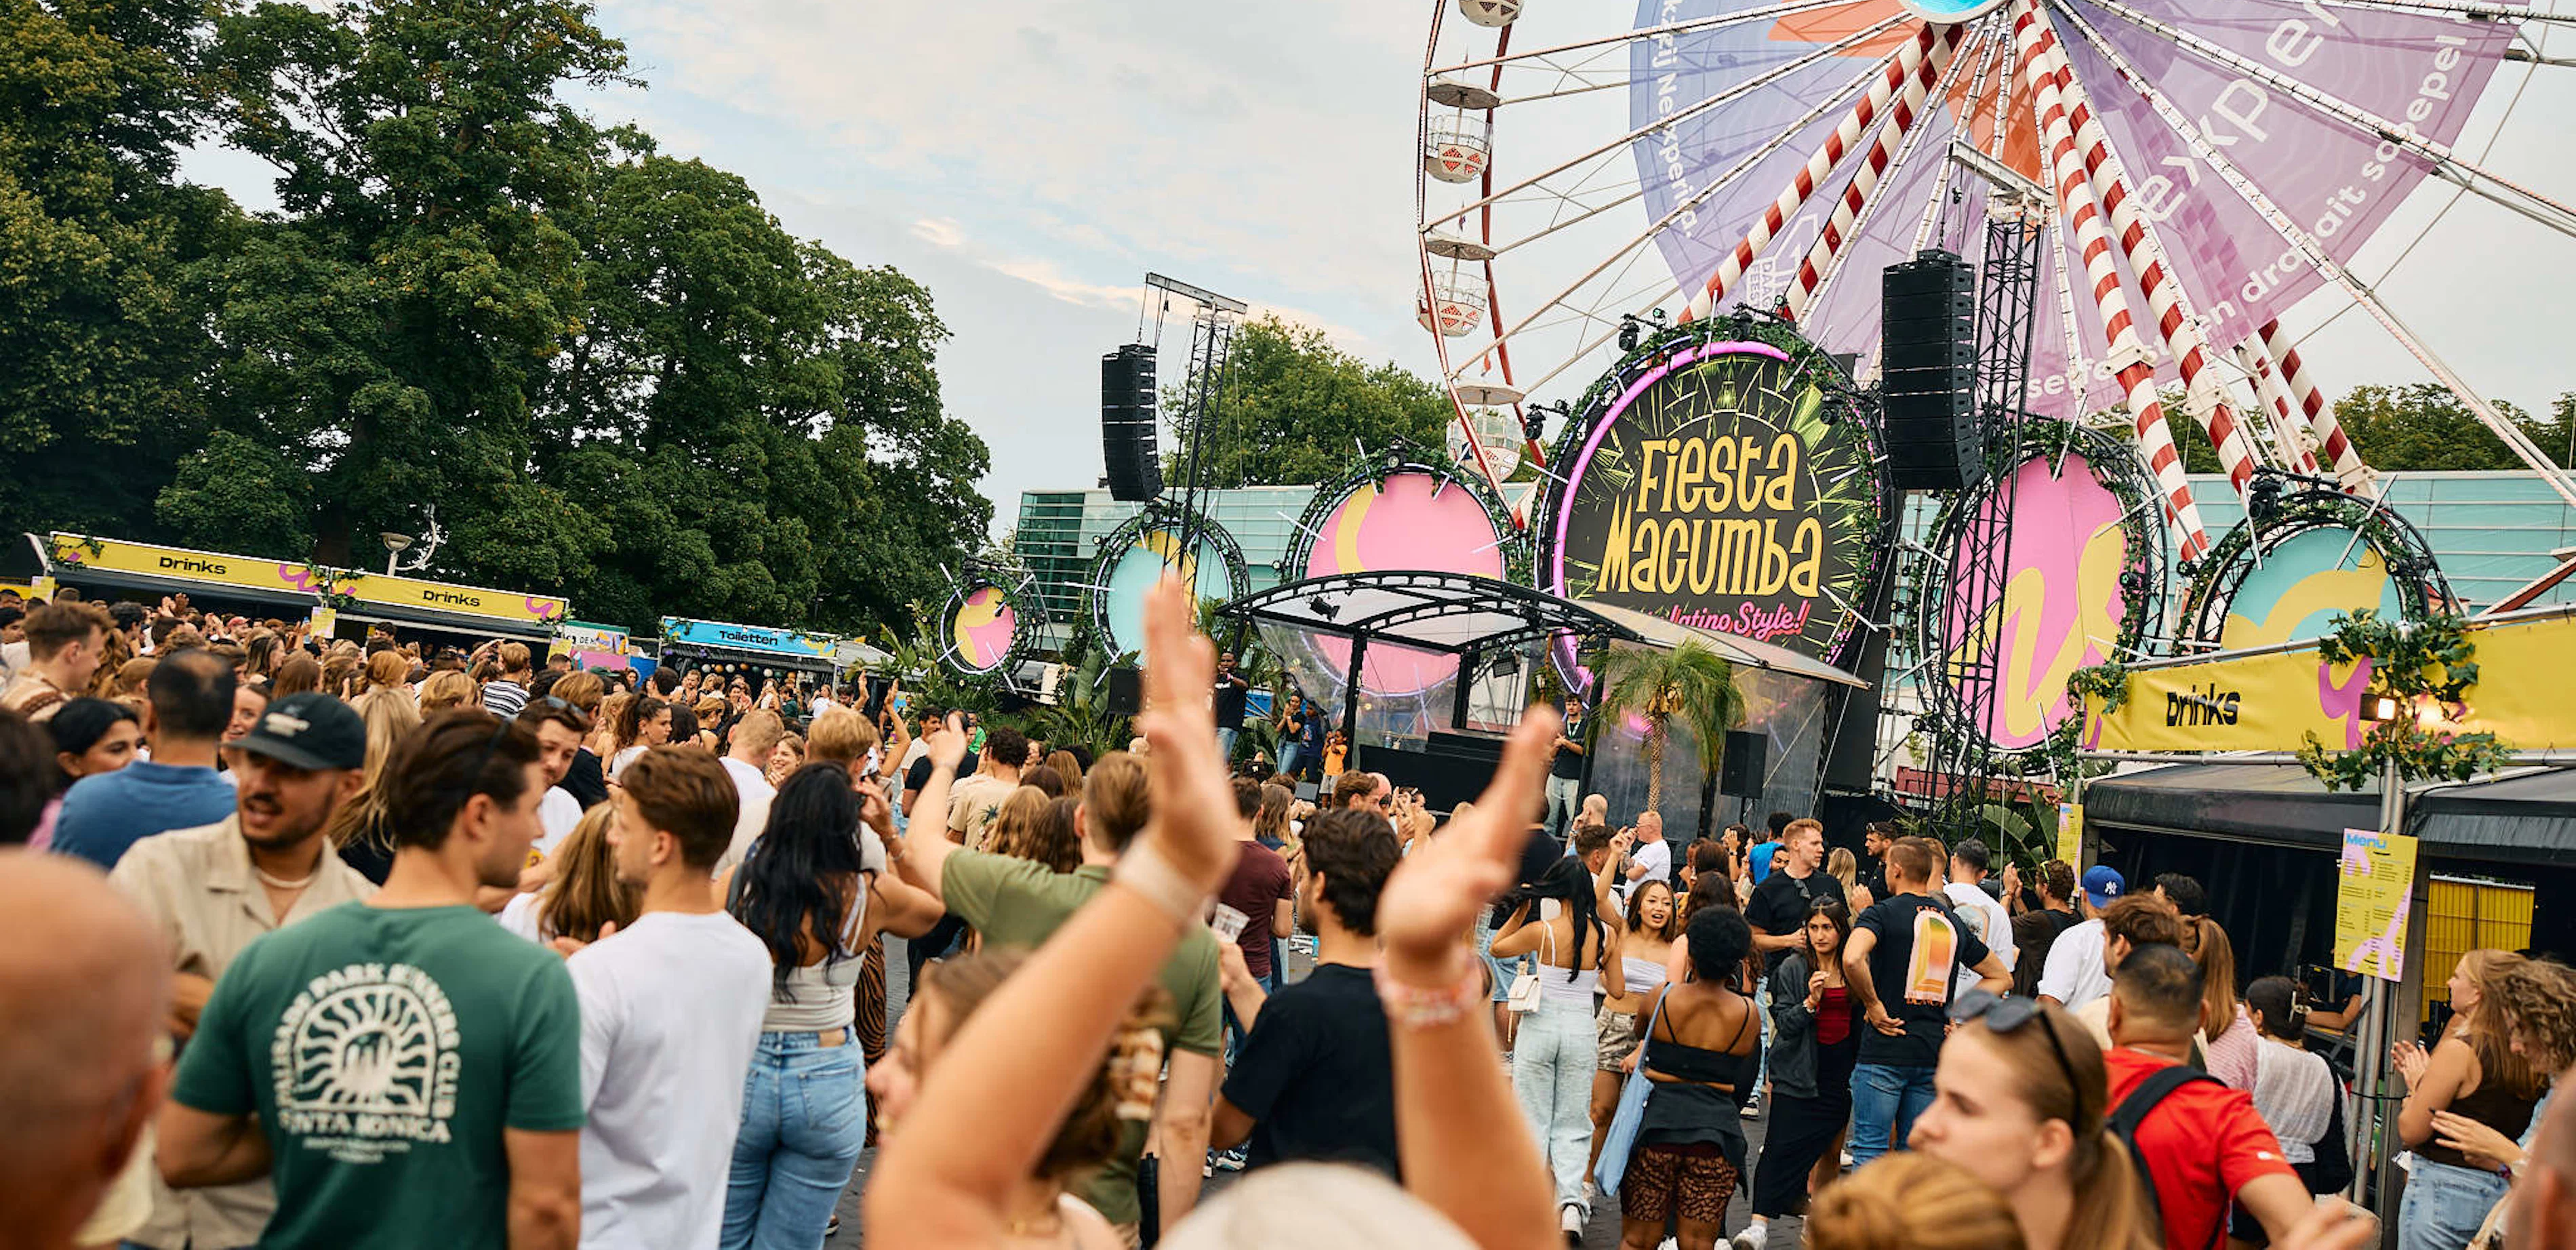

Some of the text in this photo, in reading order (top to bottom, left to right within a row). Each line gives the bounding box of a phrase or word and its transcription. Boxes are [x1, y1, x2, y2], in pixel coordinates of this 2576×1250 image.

[1636, 433, 1799, 513] Fiesta
[1596, 493, 1822, 598] Macumba
[159, 557, 226, 574] Drinks
[422, 590, 481, 607] Drinks
[1733, 599, 1811, 642] Style!
[719, 630, 778, 645] Toiletten
[2167, 683, 2240, 727] Drinks
[2346, 833, 2387, 849] Menu
